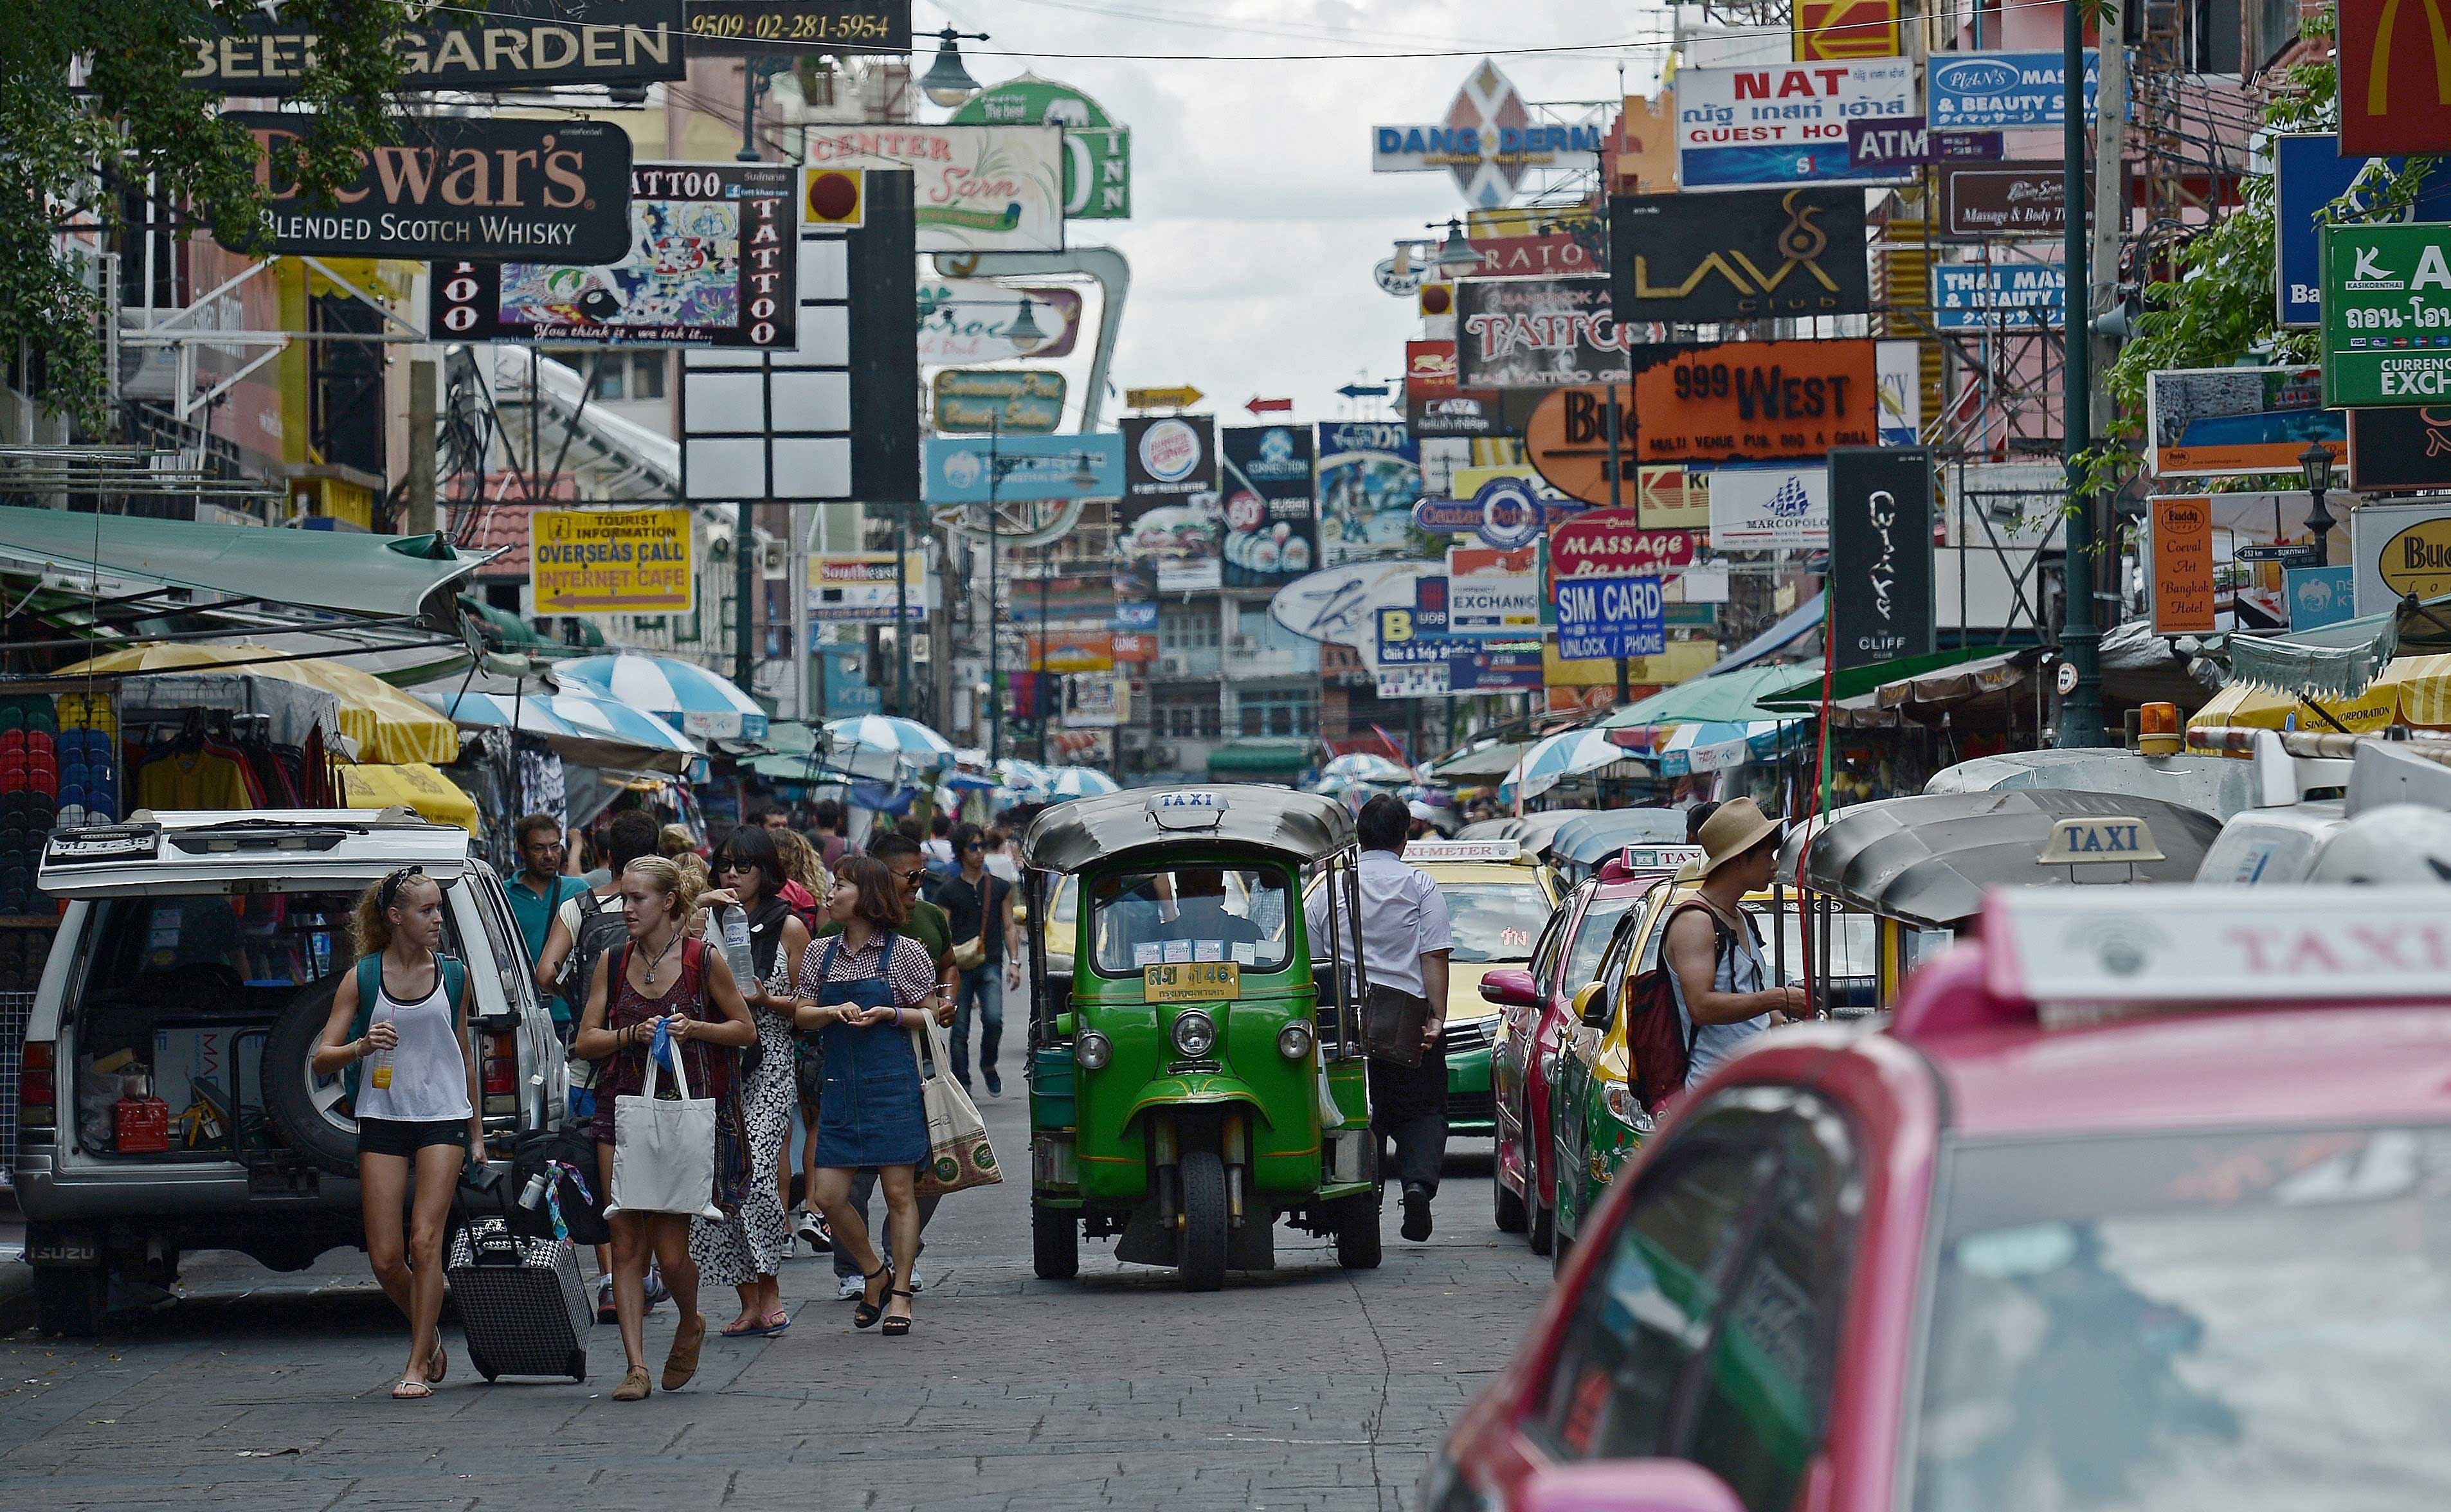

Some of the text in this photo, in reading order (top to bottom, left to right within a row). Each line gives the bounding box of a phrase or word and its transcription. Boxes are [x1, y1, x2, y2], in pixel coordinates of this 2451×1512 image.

[755, 14, 889, 39] 02-281-5954
[179, 22, 669, 78] BEE GARDEN
[1734, 68, 1849, 100] NAT
[1937, 98, 1955, 113] &
[1962, 95, 2047, 113] BEAUTY
[1379, 124, 1600, 154] DANG DERM
[1690, 123, 1847, 143] GUEST HO
[811, 133, 952, 162] CENTER
[1858, 129, 1930, 160] ATM
[632, 171, 721, 198] ATTOO
[2010, 206, 2021, 222] &
[258, 211, 577, 246] BLENDED SCOTCH WHISKY
[750, 198, 781, 345] TATTOO
[1943, 271, 2002, 290] THAI
[1971, 290, 2053, 307] BEAUTY
[534, 323, 566, 340] You
[570, 323, 610, 338] think
[637, 327, 656, 338] we
[659, 324, 685, 339] ink
[1674, 364, 1850, 420] 999 WEST
[1695, 434, 1735, 448] VENUE
[595, 514, 658, 526] TOURIST
[1423, 507, 1483, 526] Center
[1747, 518, 1830, 529] MARCOPOLO
[2167, 510, 2198, 523] Buddy
[576, 526, 676, 539] INFORMATION
[538, 542, 683, 564] OVERSEAS CALL
[1562, 534, 1683, 559] MASSAGE
[2173, 561, 2196, 573] Art
[538, 568, 685, 590] INTERNET CAFE
[2160, 580, 2210, 597] Bangkok
[1453, 594, 1536, 609] EXCHANG
[1558, 582, 1661, 625] SIM CARD
[2171, 600, 2203, 615] Hotel
[1383, 609, 1414, 642] B
[1560, 636, 1607, 658] UNLOCK
[1623, 633, 1662, 654] PHONE
[1858, 636, 1906, 651] CLIFF
[2337, 706, 2390, 723] CORPORATION
[1161, 793, 1212, 806] TAXI
[2064, 825, 2140, 852] TAXI
[1406, 845, 1492, 857] XI-METER
[1661, 852, 1700, 865] TAX
[31, 1247, 94, 1260] ISUZU
